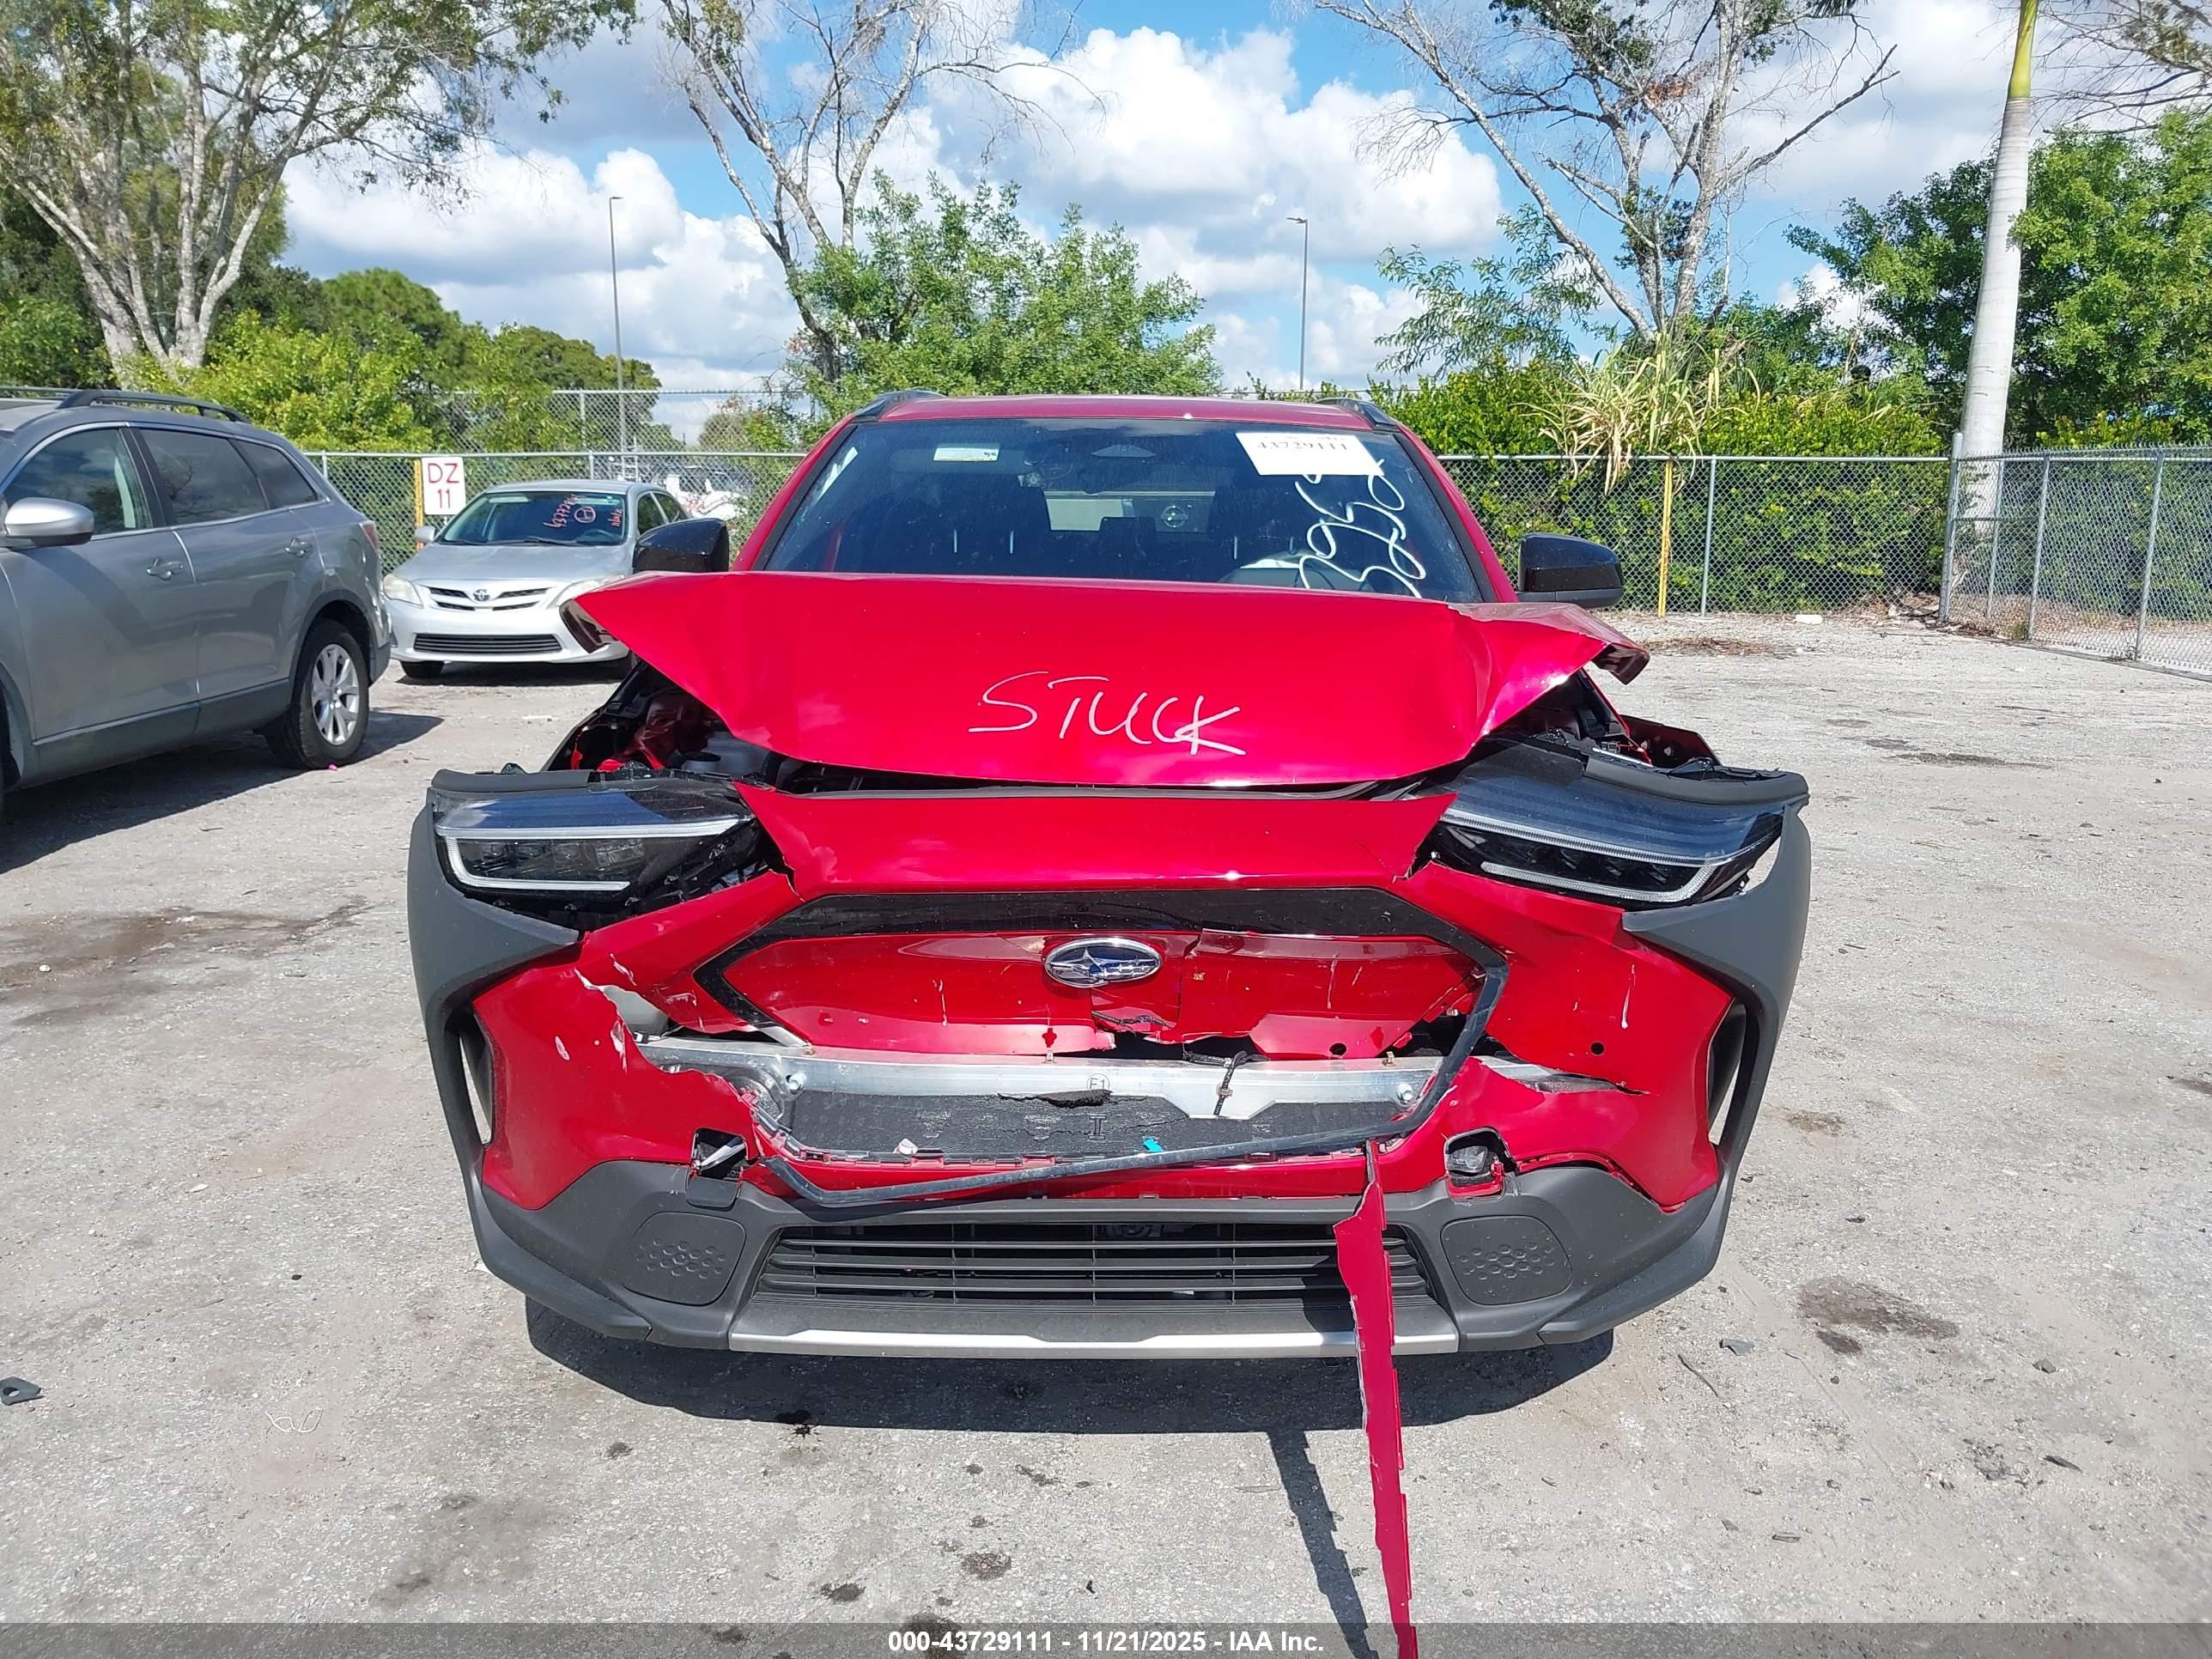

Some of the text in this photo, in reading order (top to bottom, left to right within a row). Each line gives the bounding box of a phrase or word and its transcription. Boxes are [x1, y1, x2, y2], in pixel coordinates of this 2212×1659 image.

[428, 463, 459, 483] DZ
[437, 489, 451, 508] 11
[968, 672, 1247, 755] STUCK
